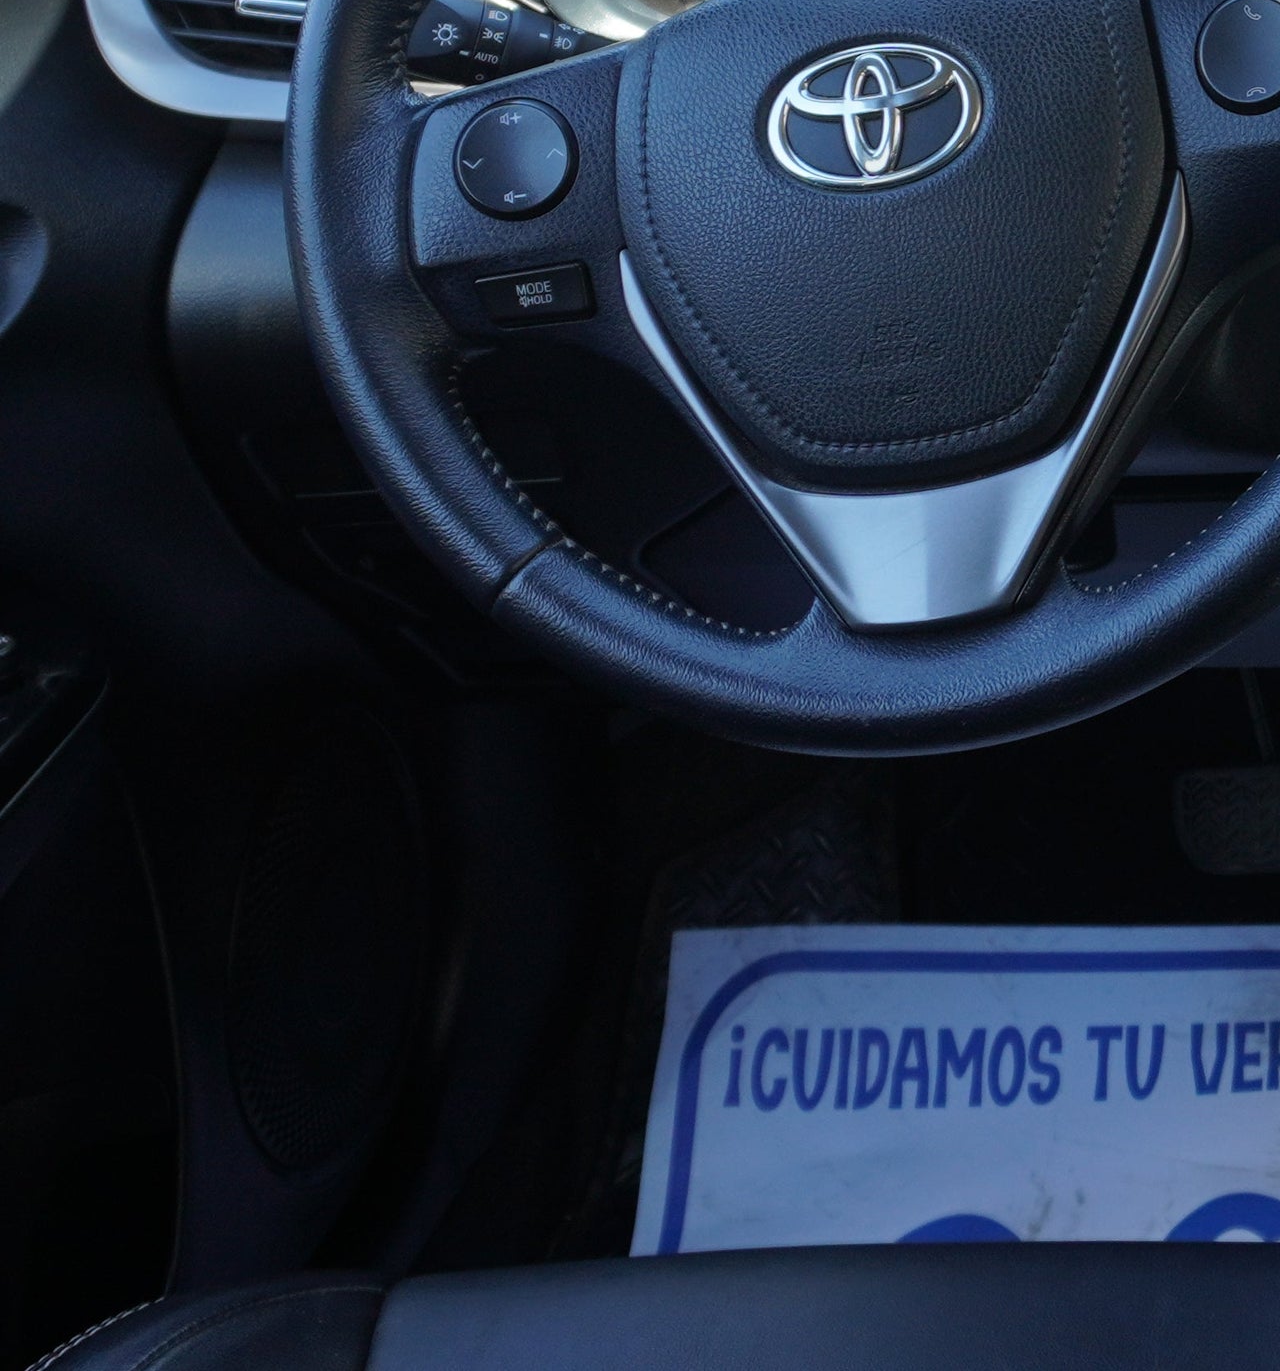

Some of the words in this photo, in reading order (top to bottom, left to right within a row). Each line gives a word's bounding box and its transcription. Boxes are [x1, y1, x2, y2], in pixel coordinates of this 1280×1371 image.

[474, 51, 499, 65] AUTO
[515, 280, 552, 296] MODE
[527, 293, 553, 306] HOLD
[722, 1024, 1063, 1112] ¡CUIDAMOS
[1086, 1023, 1166, 1102] TU
